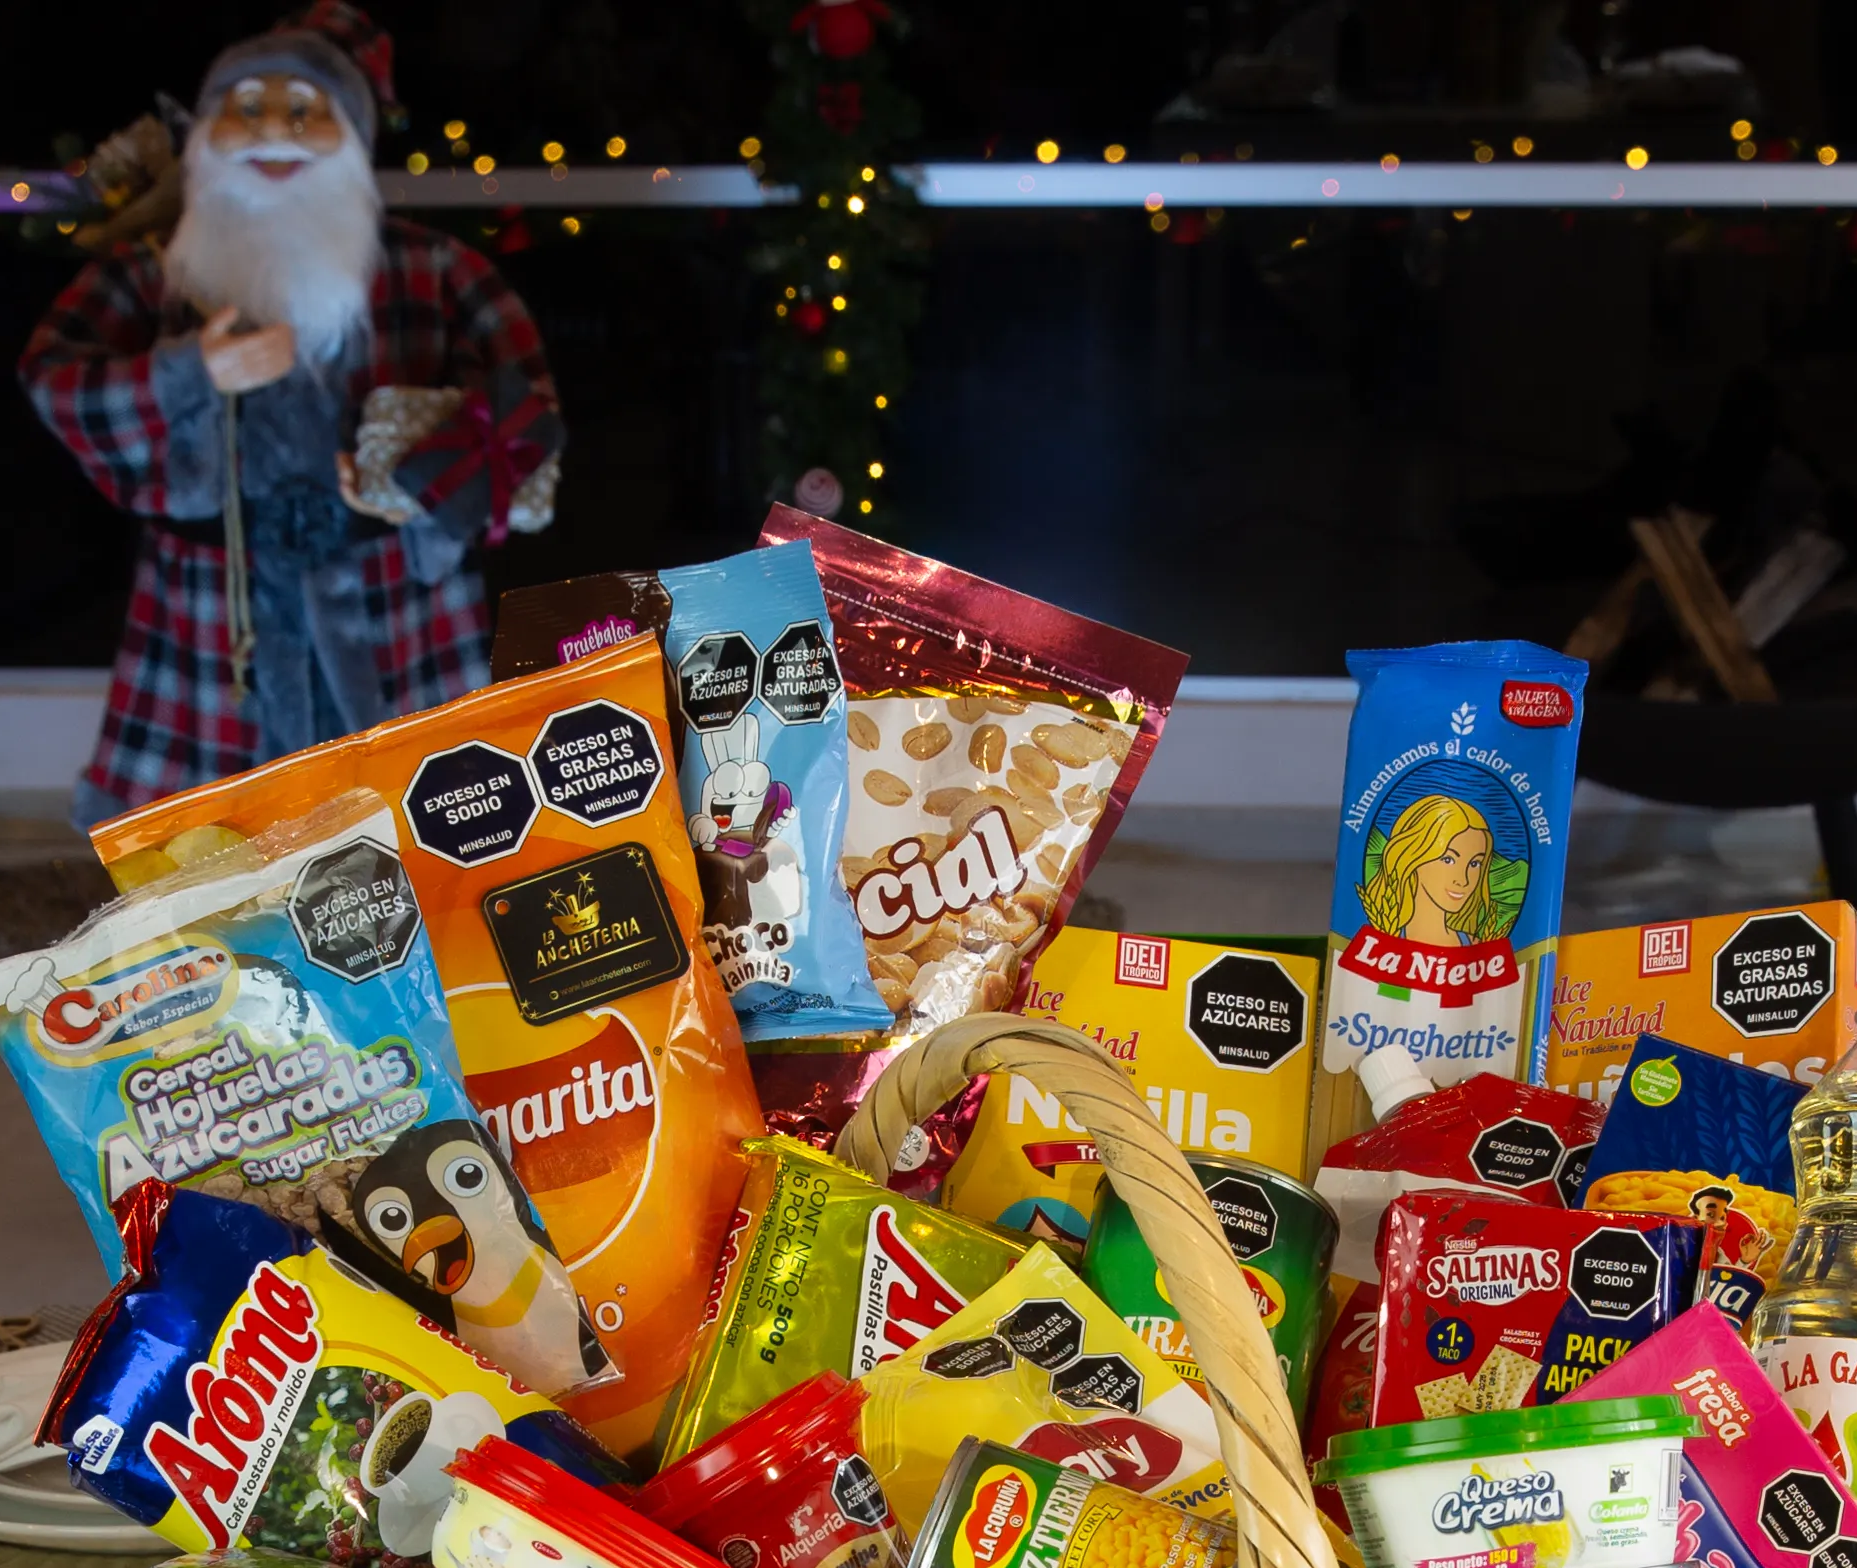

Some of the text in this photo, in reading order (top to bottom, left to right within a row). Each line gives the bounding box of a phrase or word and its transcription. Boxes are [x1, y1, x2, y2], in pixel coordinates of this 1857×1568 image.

[693, 665, 747, 684] EXCESO EN
[546, 725, 633, 763] EXCESO EN
[559, 743, 634, 779] GRASAS
[424, 774, 512, 813] EXCESO EN
[550, 758, 657, 802] SATURADAS
[1344, 739, 1552, 846] Alimentamos el calor de hogar
[445, 795, 502, 825] SODIO
[584, 789, 639, 814] MINSALUD
[458, 829, 514, 855] MINSALUD
[311, 877, 395, 923] EXCESO EN
[315, 895, 407, 946] AZÚCARES
[345, 940, 397, 969] MINSALUD
[536, 916, 641, 970] ANCHETERIA
[1125, 942, 1161, 968] DEL
[1354, 935, 1506, 986] La Nieve
[1648, 931, 1682, 956] DEL
[1733, 944, 1816, 966] EXCESO EN
[1723, 980, 1823, 1005] SATURADAS
[1739, 963, 1808, 985] GRASAS
[43, 951, 218, 1044] Carolina
[124, 992, 215, 1036] Sabor Especial
[1207, 992, 1289, 1014] EXCESO EN
[1747, 1009, 1798, 1023] MINSALUD
[1201, 1007, 1291, 1034] AZÚCARES
[128, 1032, 252, 1100] Cereal
[1219, 1045, 1270, 1061] MINSALUD
[138, 1044, 330, 1146] Hojuelas
[101, 1044, 414, 1196] Azucaradas
[242, 1091, 426, 1185] Sugar Flakes
[757, 1170, 811, 1311] 16 PORCIONES
[760, 1178, 830, 1365] CONT. NETO: 500 g
[1427, 1249, 1561, 1298] SALTINAS
[1584, 1258, 1647, 1274] EXCESO EN
[1593, 1273, 1634, 1288] SODIO
[1460, 1283, 1516, 1301] ORIGINAL
[1591, 1300, 1630, 1311] MINSALUD
[1438, 1347, 1461, 1361] TACO
[1565, 1334, 1631, 1363] PACK
[1781, 1353, 1819, 1392] LA
[147, 1265, 320, 1549] Aroma
[1672, 1368, 1747, 1447] fresa
[1718, 1381, 1750, 1422] sabor a
[225, 1368, 307, 1531] Café tostado y molido
[1461, 1471, 1553, 1502] Queso
[974, 1478, 1022, 1562] LA CORUÑA
[1774, 1488, 1817, 1543] AZÚCARES
[1787, 1483, 1826, 1533] EXCESO EN
[779, 1512, 847, 1567] Alquería
[1073, 1508, 1105, 1551] CORN
[1765, 1513, 1789, 1544] MINSALUD
[1456, 1555, 1487, 1568] neto:
[1489, 1549, 1508, 1564] 150
[1509, 1550, 1518, 1563] g
